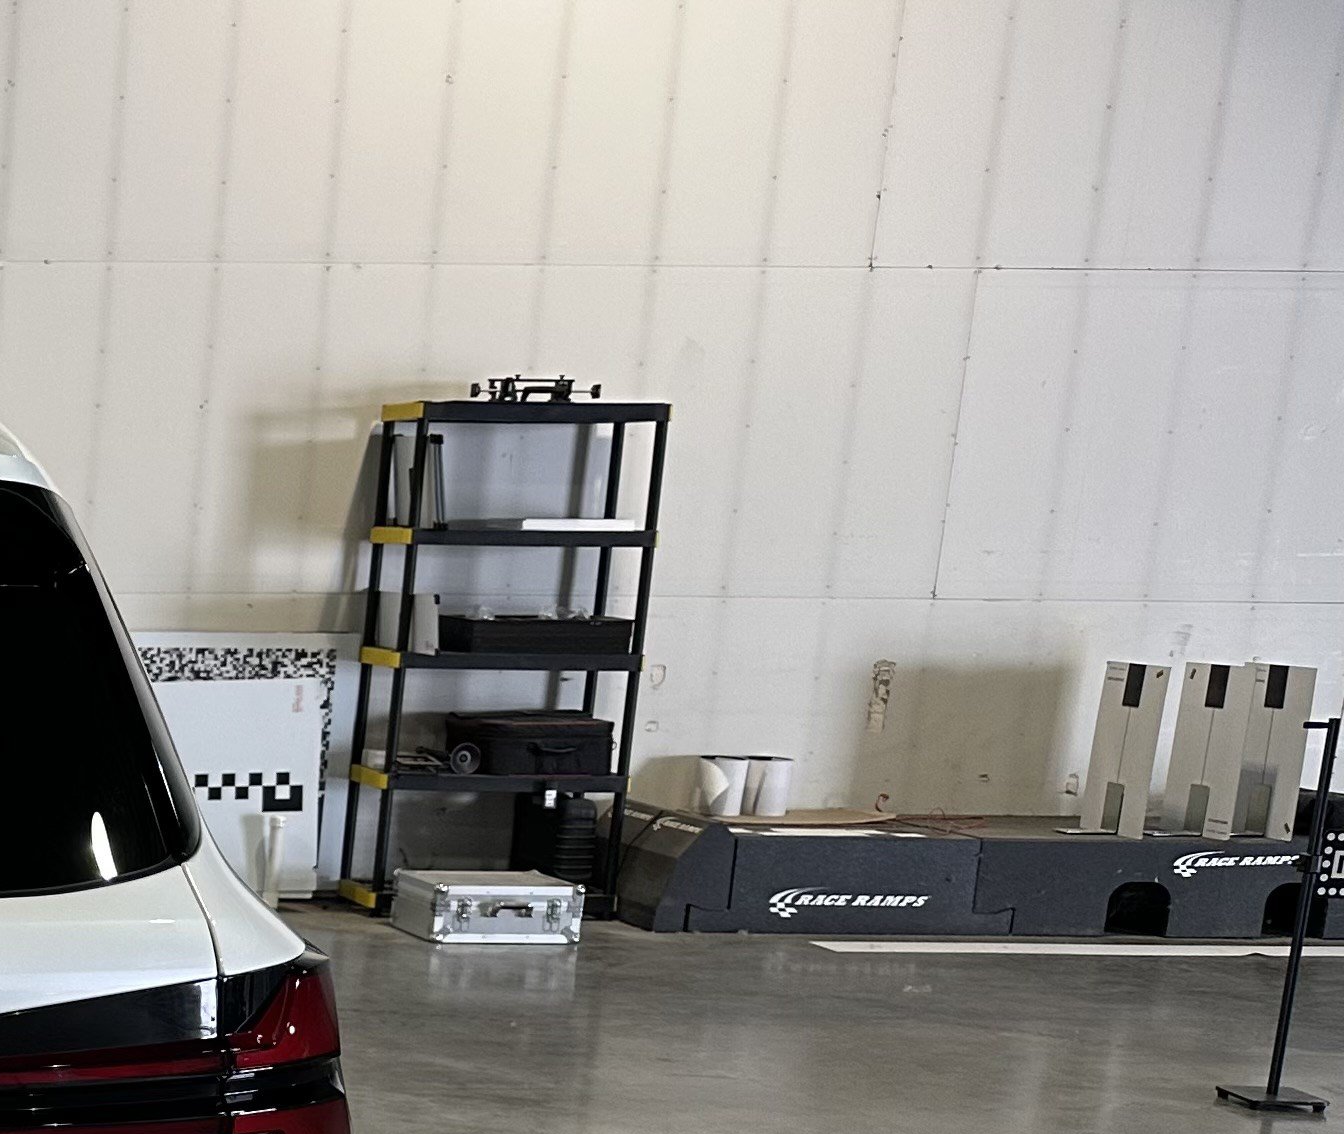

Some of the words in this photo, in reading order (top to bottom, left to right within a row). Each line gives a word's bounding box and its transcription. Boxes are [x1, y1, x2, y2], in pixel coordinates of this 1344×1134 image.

[1193, 856, 1240, 868] RACE
[794, 894, 853, 906] RACE
[851, 895, 929, 907] RAMPS
